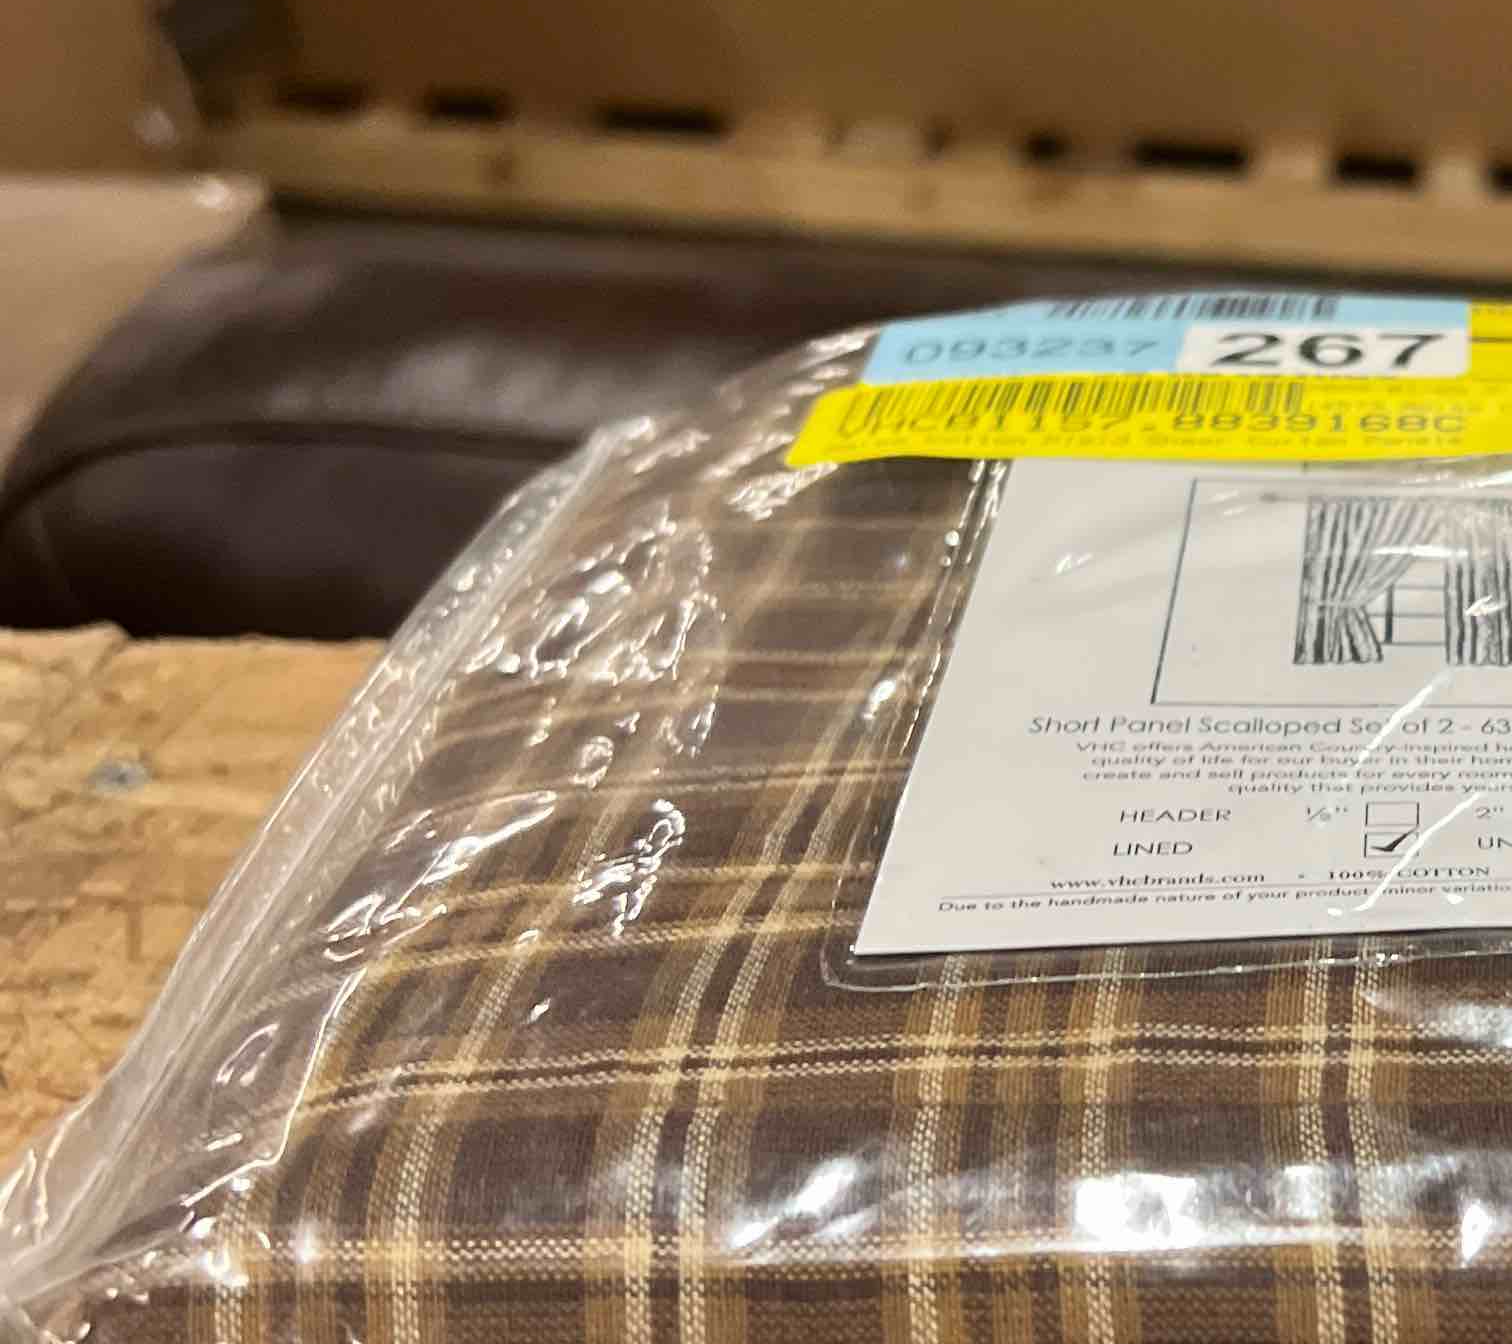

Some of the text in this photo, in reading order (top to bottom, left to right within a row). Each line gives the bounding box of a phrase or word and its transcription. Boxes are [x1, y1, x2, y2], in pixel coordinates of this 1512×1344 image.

[904, 332, 1446, 369] 093237 267
[1028, 716, 1100, 735] Short
[1110, 716, 1191, 735] Panel
[1199, 716, 1341, 737] Scalloped
[1401, 717, 1428, 735] of
[1437, 717, 1453, 735] 2
[1132, 741, 1193, 753] offers
[1199, 741, 1302, 753] American
[1091, 755, 1165, 769] quality
[1172, 755, 1196, 765] of
[1202, 754, 1233, 766] life
[1241, 754, 1271, 766] for
[1277, 757, 1312, 766] our
[1390, 755, 1410, 766] in
[1416, 754, 1463, 766] their
[1082, 770, 1153, 781] create
[1160, 769, 1201, 781] and
[1208, 768, 1244, 780] sell
[1250, 769, 1348, 783] products
[1355, 768, 1384, 780] for
[1391, 769, 1451, 783] every
[1227, 783, 1303, 797] quality
[1310, 782, 1352, 794] that
[1358, 781, 1457, 797] provides
[1119, 808, 1232, 824] HEADER
[1112, 840, 1194, 857] LINED
[1050, 871, 1266, 889] www.vhcbrands.com
[1395, 866, 1490, 879] COTTON
[937, 900, 978, 912] Due
[984, 899, 1006, 910] to
[1011, 897, 1042, 908] the
[1048, 893, 1150, 906] handmade
[1155, 892, 1217, 904] nature
[1222, 890, 1242, 901] of
[1247, 891, 1288, 905] your
[1381, 886, 1435, 897] minor
